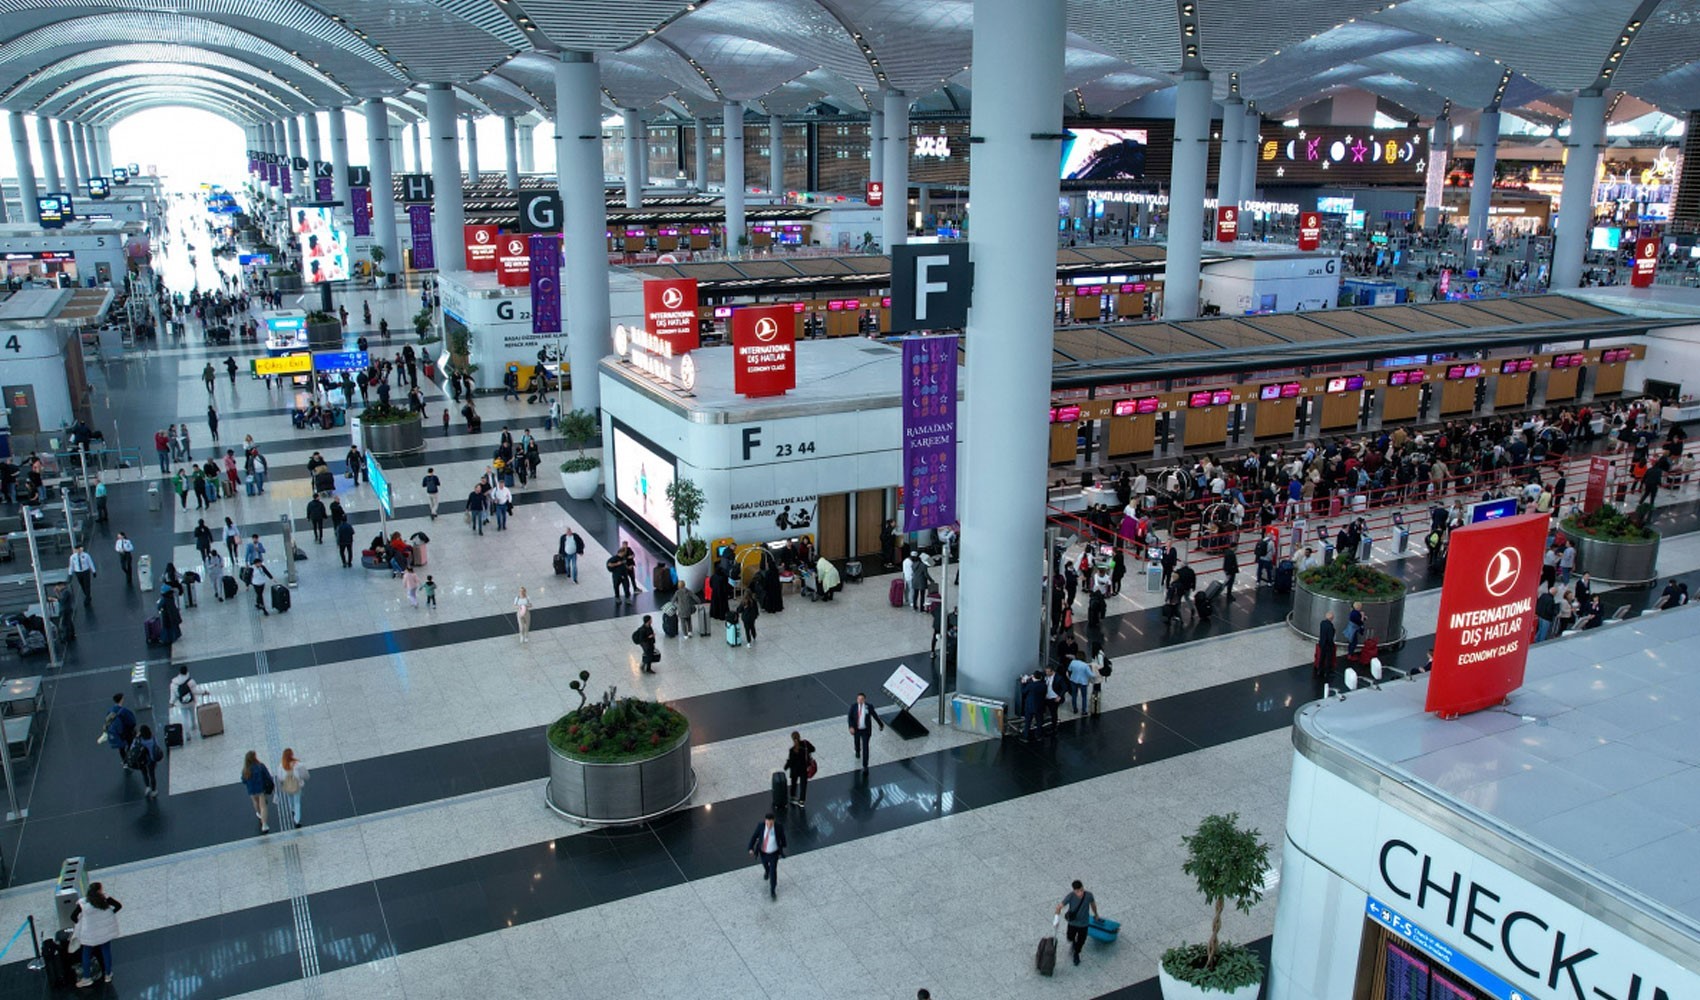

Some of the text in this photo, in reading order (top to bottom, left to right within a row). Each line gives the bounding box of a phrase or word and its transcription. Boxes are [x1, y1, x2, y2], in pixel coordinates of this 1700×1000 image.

[318, 163, 328, 175] K
[354, 168, 362, 184] J
[408, 178, 427, 199] H
[527, 196, 554, 228] G
[1244, 200, 1299, 215] DEPARTURES
[97, 237, 104, 247] 5
[1326, 260, 1335, 274] G
[915, 254, 950, 320] F
[497, 301, 514, 320] G
[5, 335, 21, 352] 4
[739, 344, 791, 354] INTERNATIONAL
[747, 353, 785, 364] DIŞ HATLAR
[906, 422, 954, 437] RAMADAN
[742, 427, 815, 460] F 23 44
[910, 435, 949, 448] KAREEM
[731, 512, 756, 520] REPACK
[1450, 597, 1532, 629] INTERNATIONAL
[1461, 617, 1522, 646] DIŞ HATLAR
[1458, 640, 1519, 666] ECONOMY CLASS
[1379, 839, 1669, 1000] CHECK-I
[1392, 914, 1412, 936] F-S
